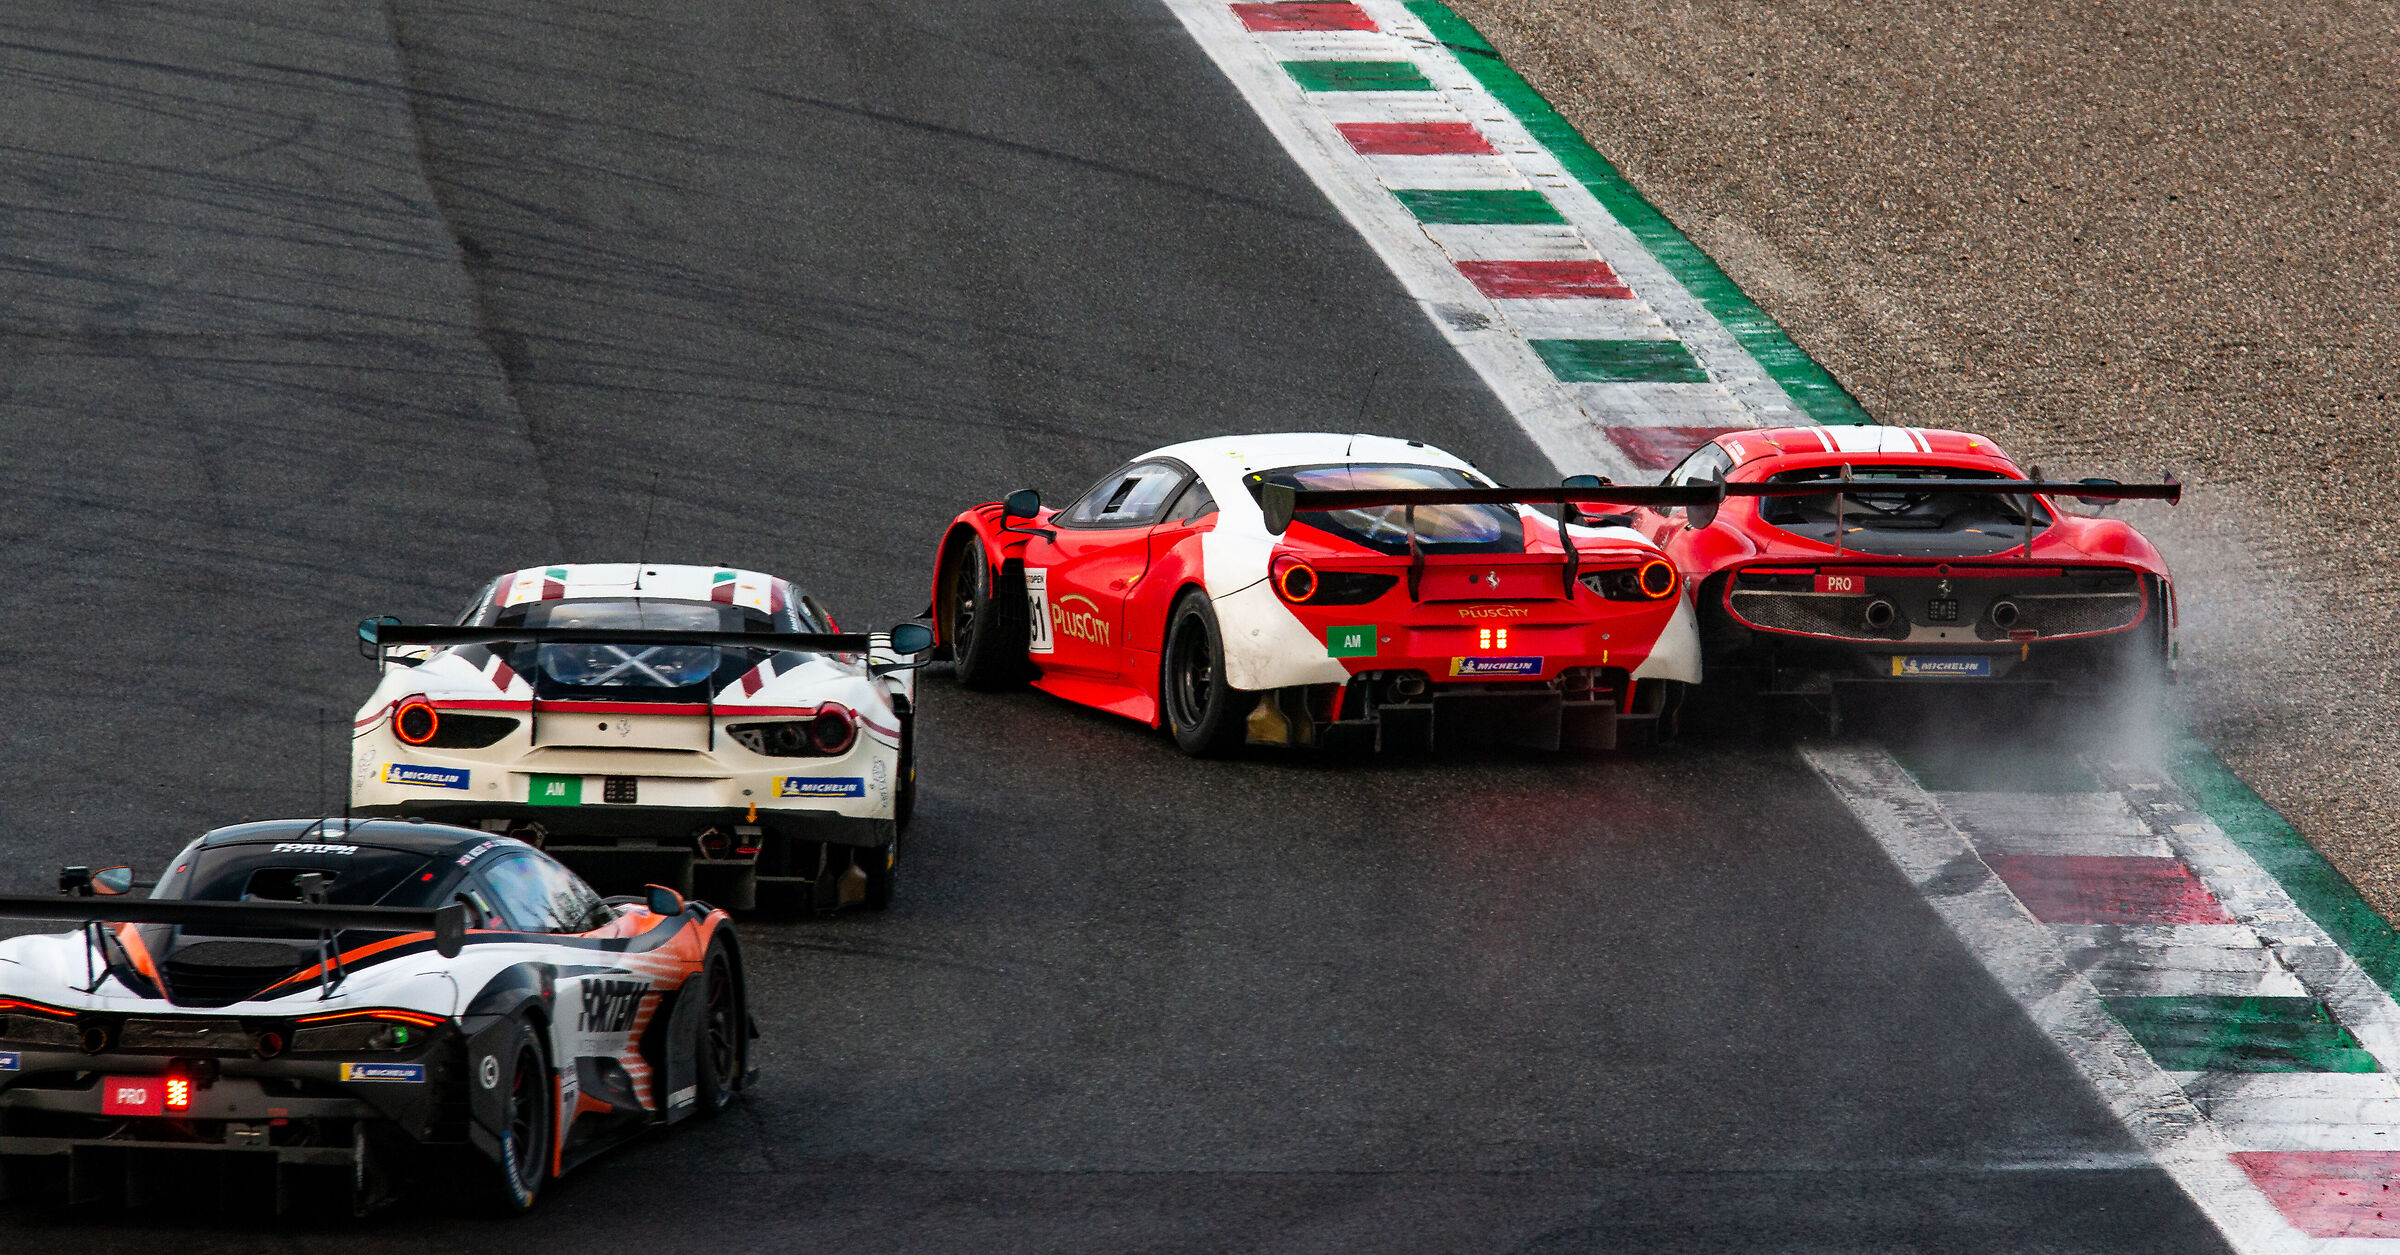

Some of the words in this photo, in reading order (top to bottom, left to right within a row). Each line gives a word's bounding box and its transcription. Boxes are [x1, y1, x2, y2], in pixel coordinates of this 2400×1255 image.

[1828, 576, 1852, 591] PRO
[1343, 634, 1361, 648] AM
[1477, 662, 1533, 670] MICHELIN
[1921, 662, 1979, 670] MICHELIN
[401, 770, 460, 783] MICHELIN
[545, 782, 566, 796] AM
[800, 784, 858, 792] MICHELIN
[577, 978, 651, 1033] FORTEM
[117, 1088, 147, 1105] PRO
